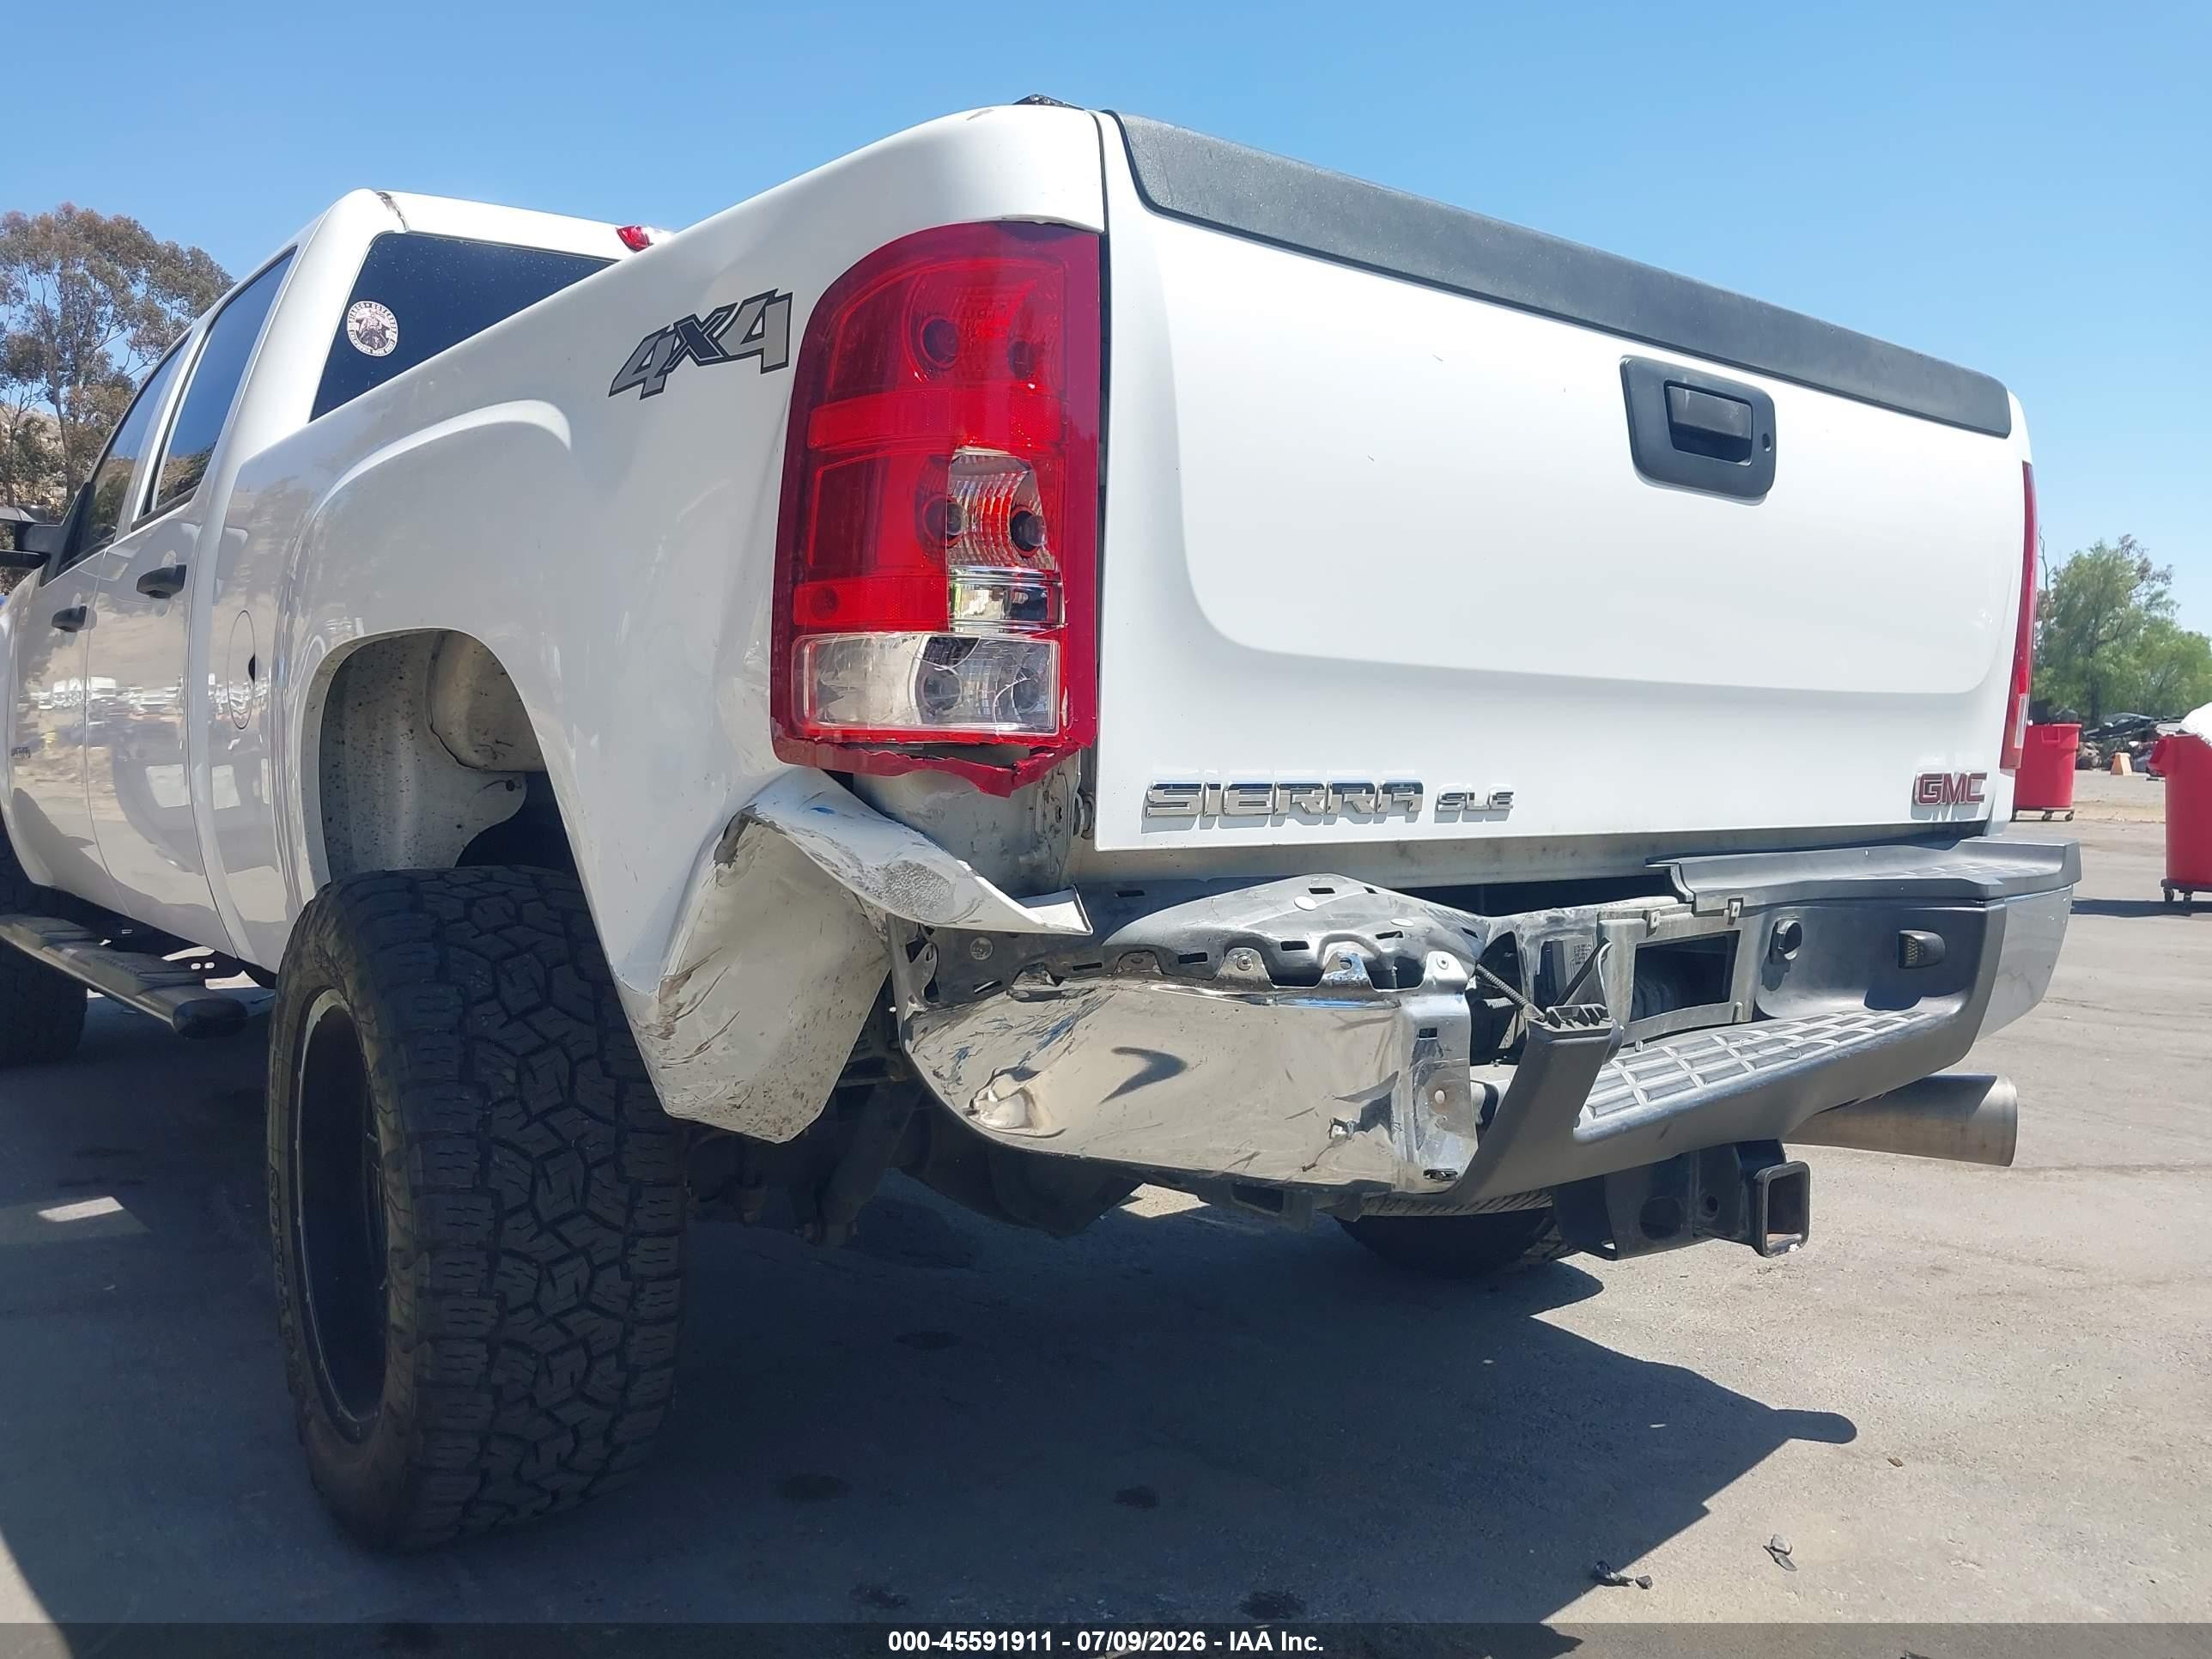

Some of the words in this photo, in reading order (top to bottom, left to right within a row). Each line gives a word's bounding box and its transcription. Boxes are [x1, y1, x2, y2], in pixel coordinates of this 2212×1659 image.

[1146, 781, 1424, 817] SIERRA
[1437, 791, 1514, 811] SLE
[1914, 772, 1988, 805] GMC
